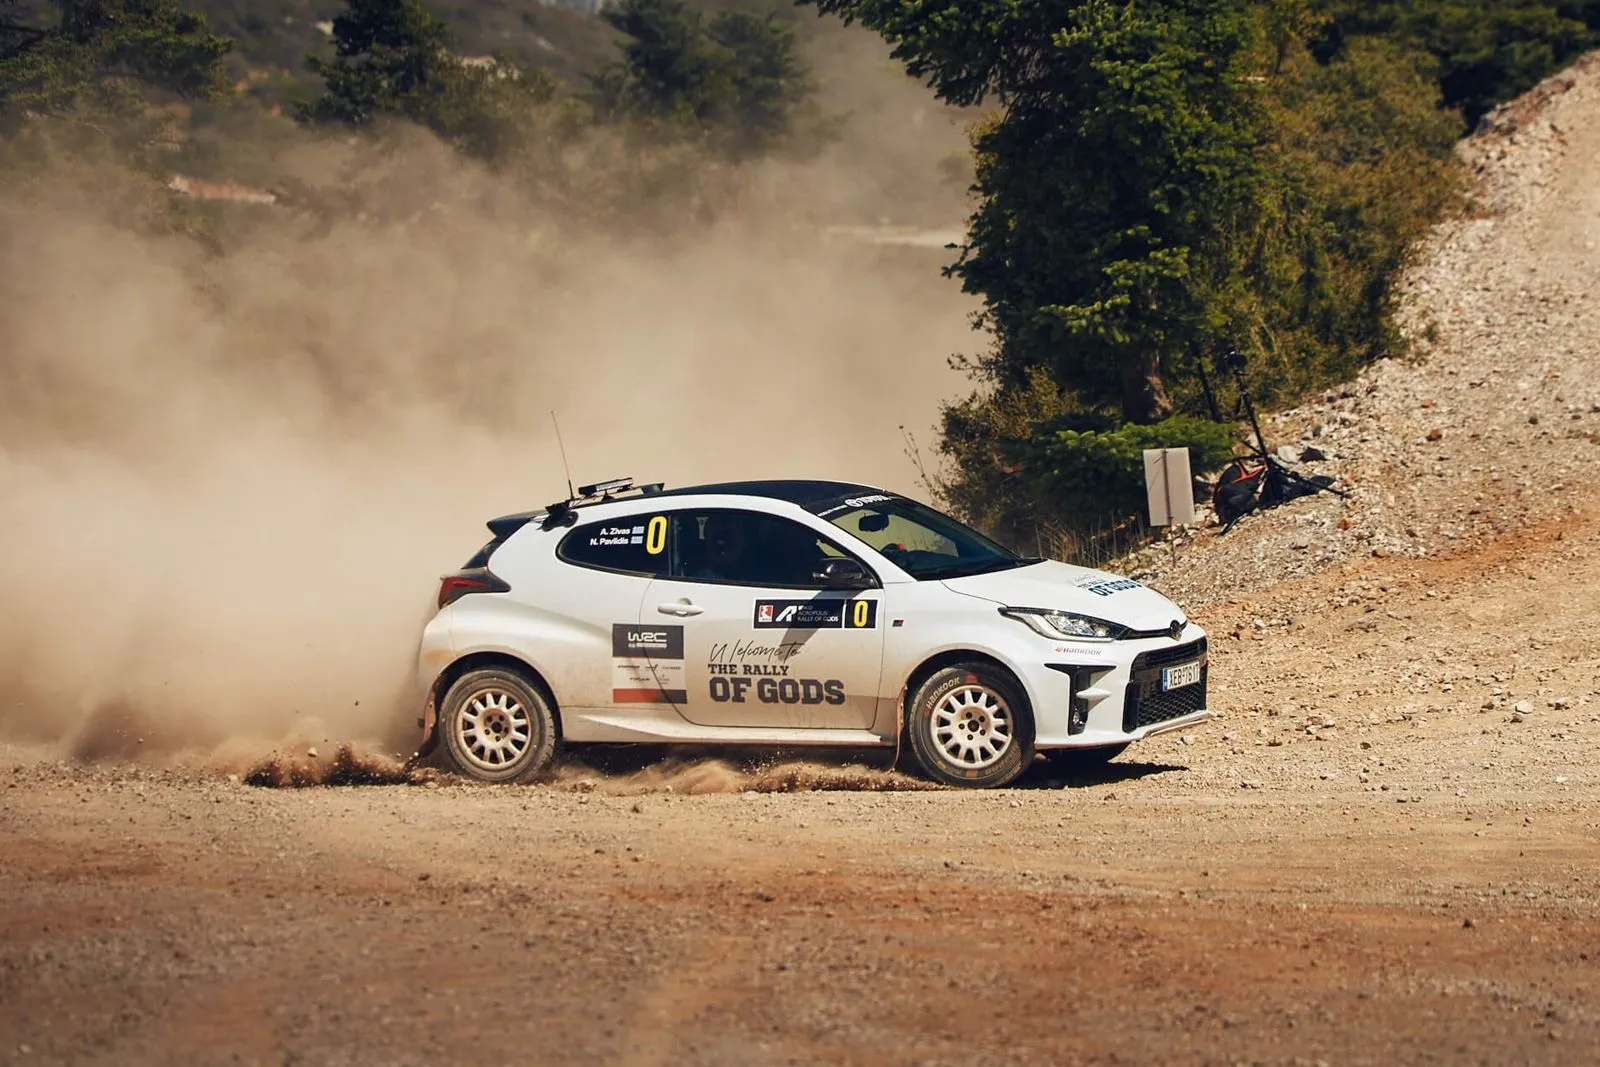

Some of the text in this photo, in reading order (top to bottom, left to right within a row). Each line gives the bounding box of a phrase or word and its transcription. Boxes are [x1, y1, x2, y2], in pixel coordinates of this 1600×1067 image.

[610, 527, 631, 535] Zivas
[646, 516, 667, 554] 0
[590, 537, 628, 546] N. Pavlidis
[853, 600, 868, 627] 0
[628, 631, 667, 642] WRC
[709, 639, 784, 663] Welcome
[708, 664, 789, 676] THE RALLY
[709, 677, 846, 705] OF GODS
